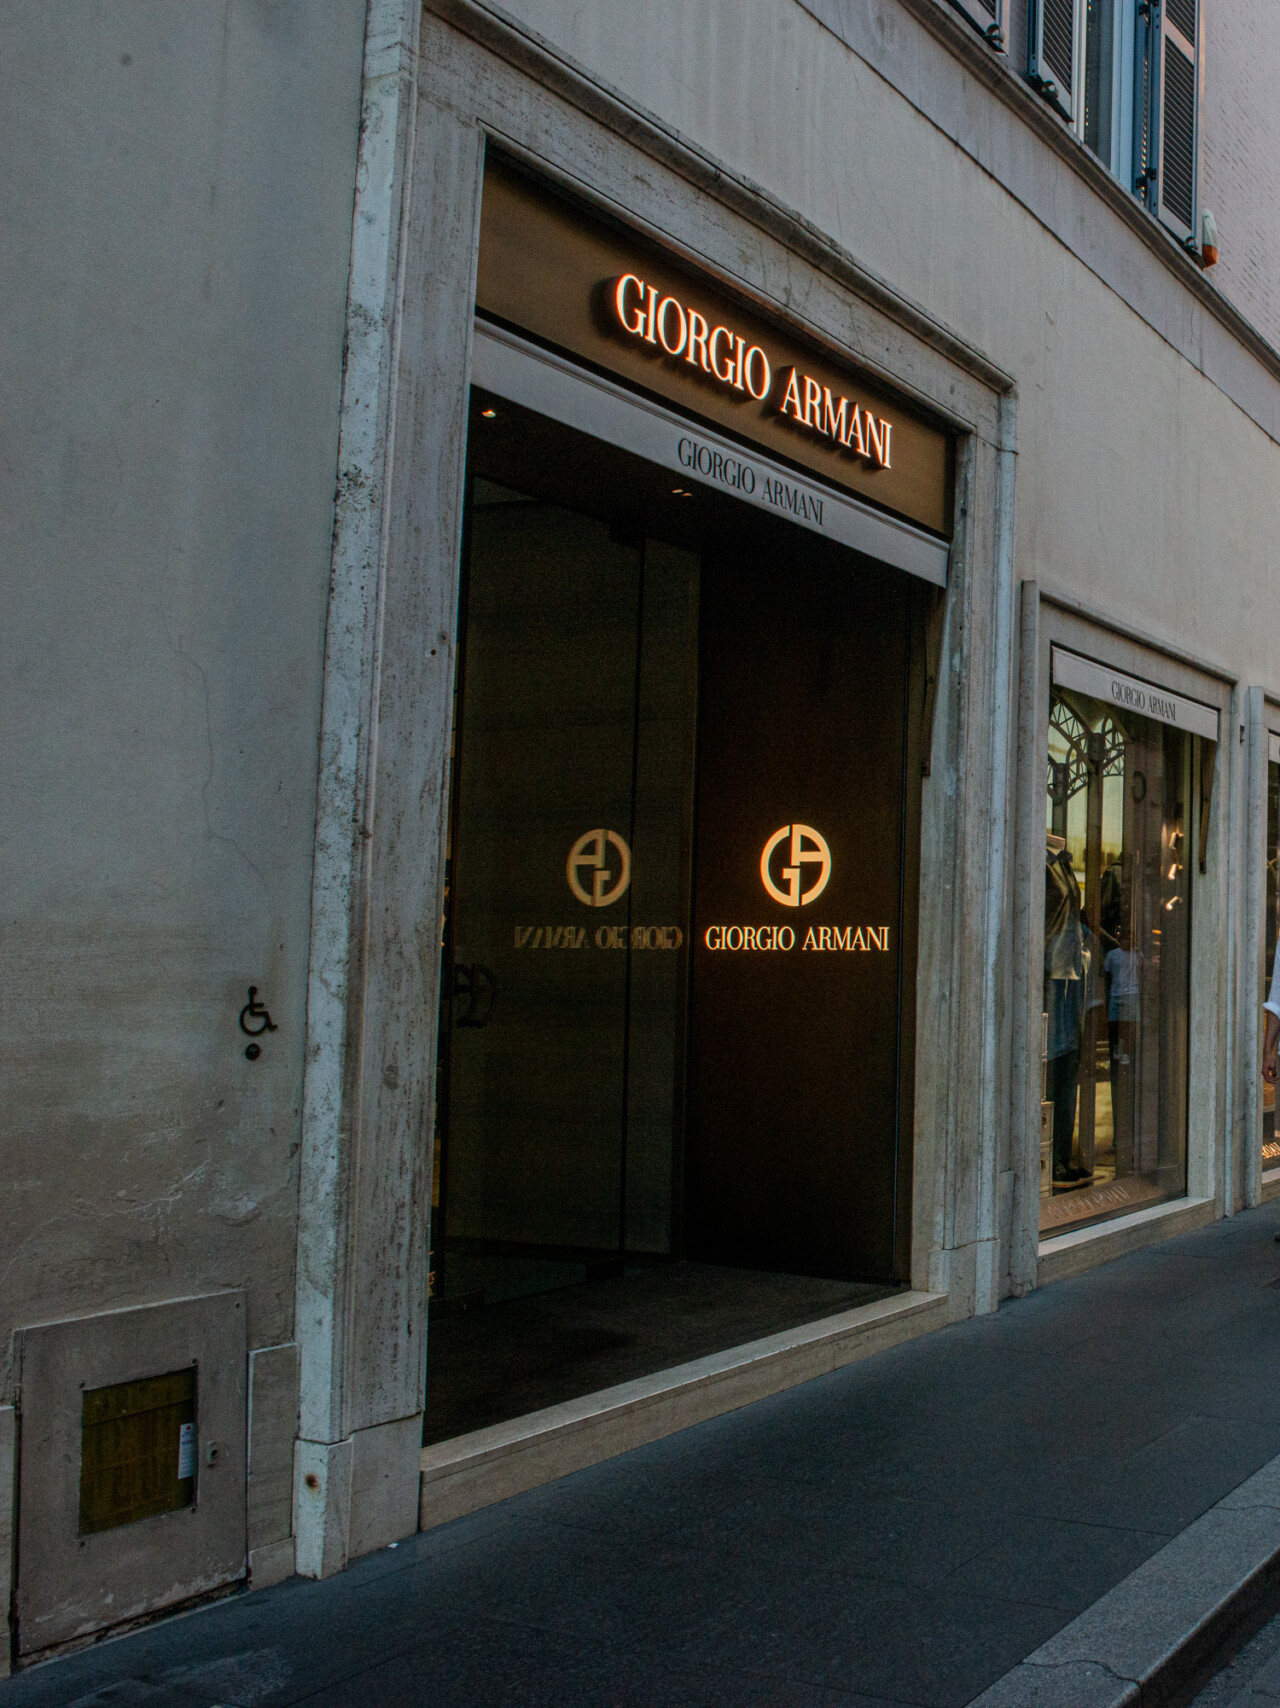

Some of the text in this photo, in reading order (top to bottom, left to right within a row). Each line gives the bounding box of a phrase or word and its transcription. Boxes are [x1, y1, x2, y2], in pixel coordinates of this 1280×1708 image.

[614, 273, 893, 470] GIORGIO ARMANI
[677, 437, 824, 527] GIORGIO ARMANI
[1111, 680, 1176, 721] GIORGIO ARMANI
[704, 925, 890, 952] GIORGIO ARMANI
